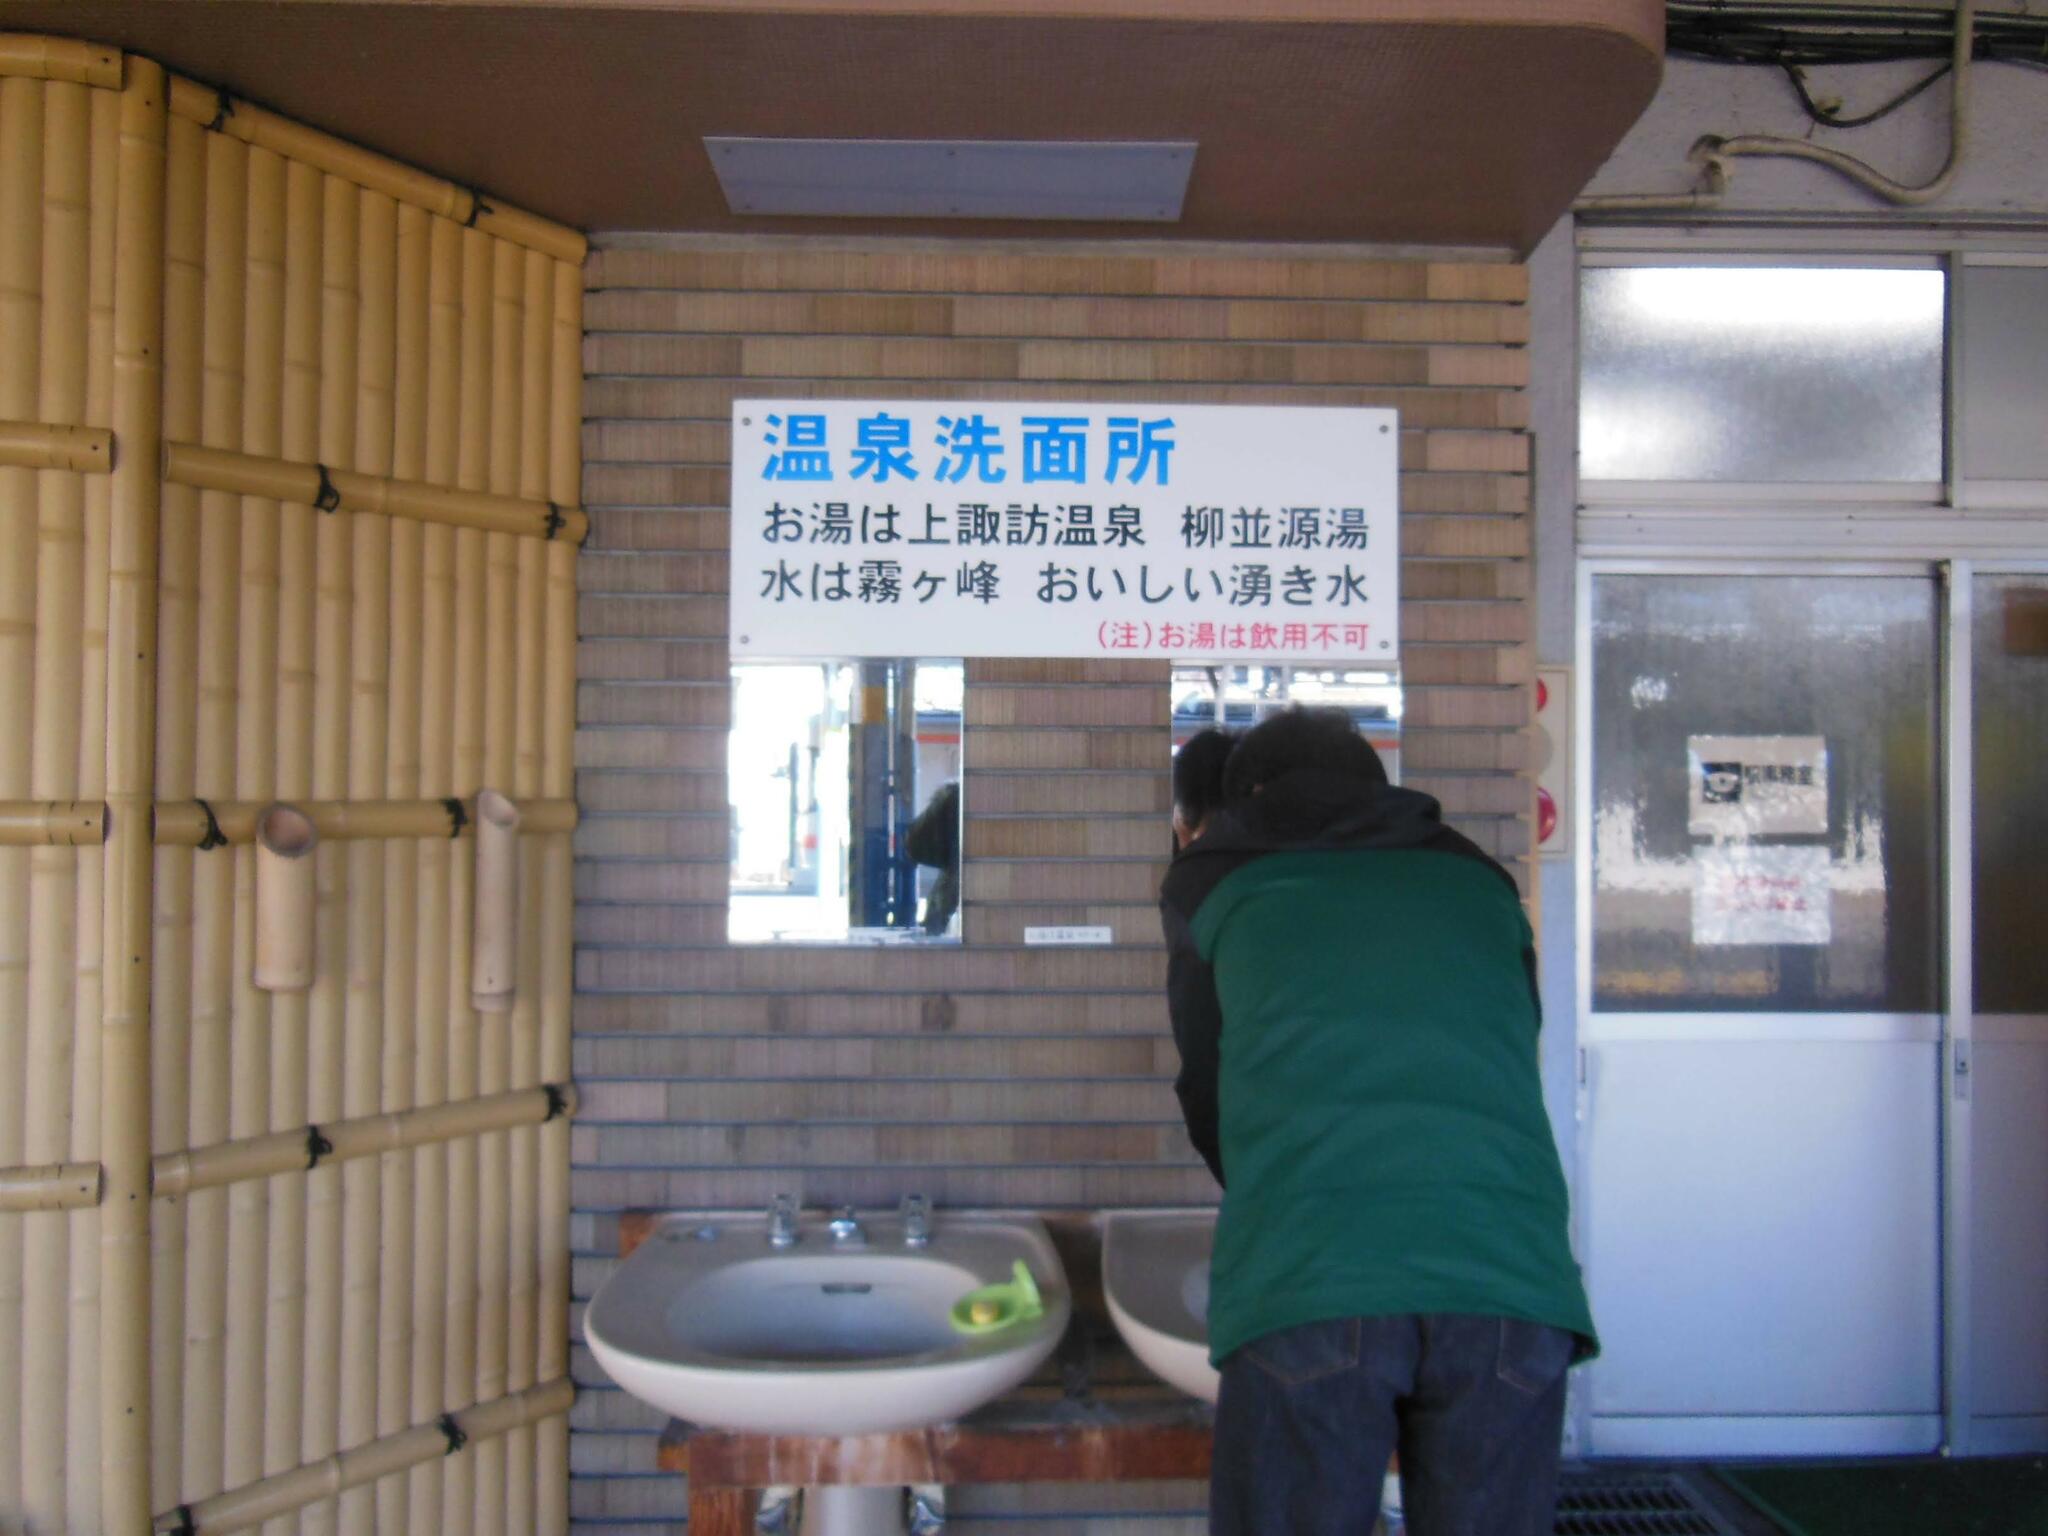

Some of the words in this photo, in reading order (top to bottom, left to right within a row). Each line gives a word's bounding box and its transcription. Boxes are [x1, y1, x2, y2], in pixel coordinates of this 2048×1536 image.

[761, 412, 1177, 487] 温泉洗面所
[763, 502, 1147, 549] お湯は上諏訪温泉
[1181, 506, 1370, 551] 柳並源湯
[1037, 563, 1369, 608] おいしい湧き水
